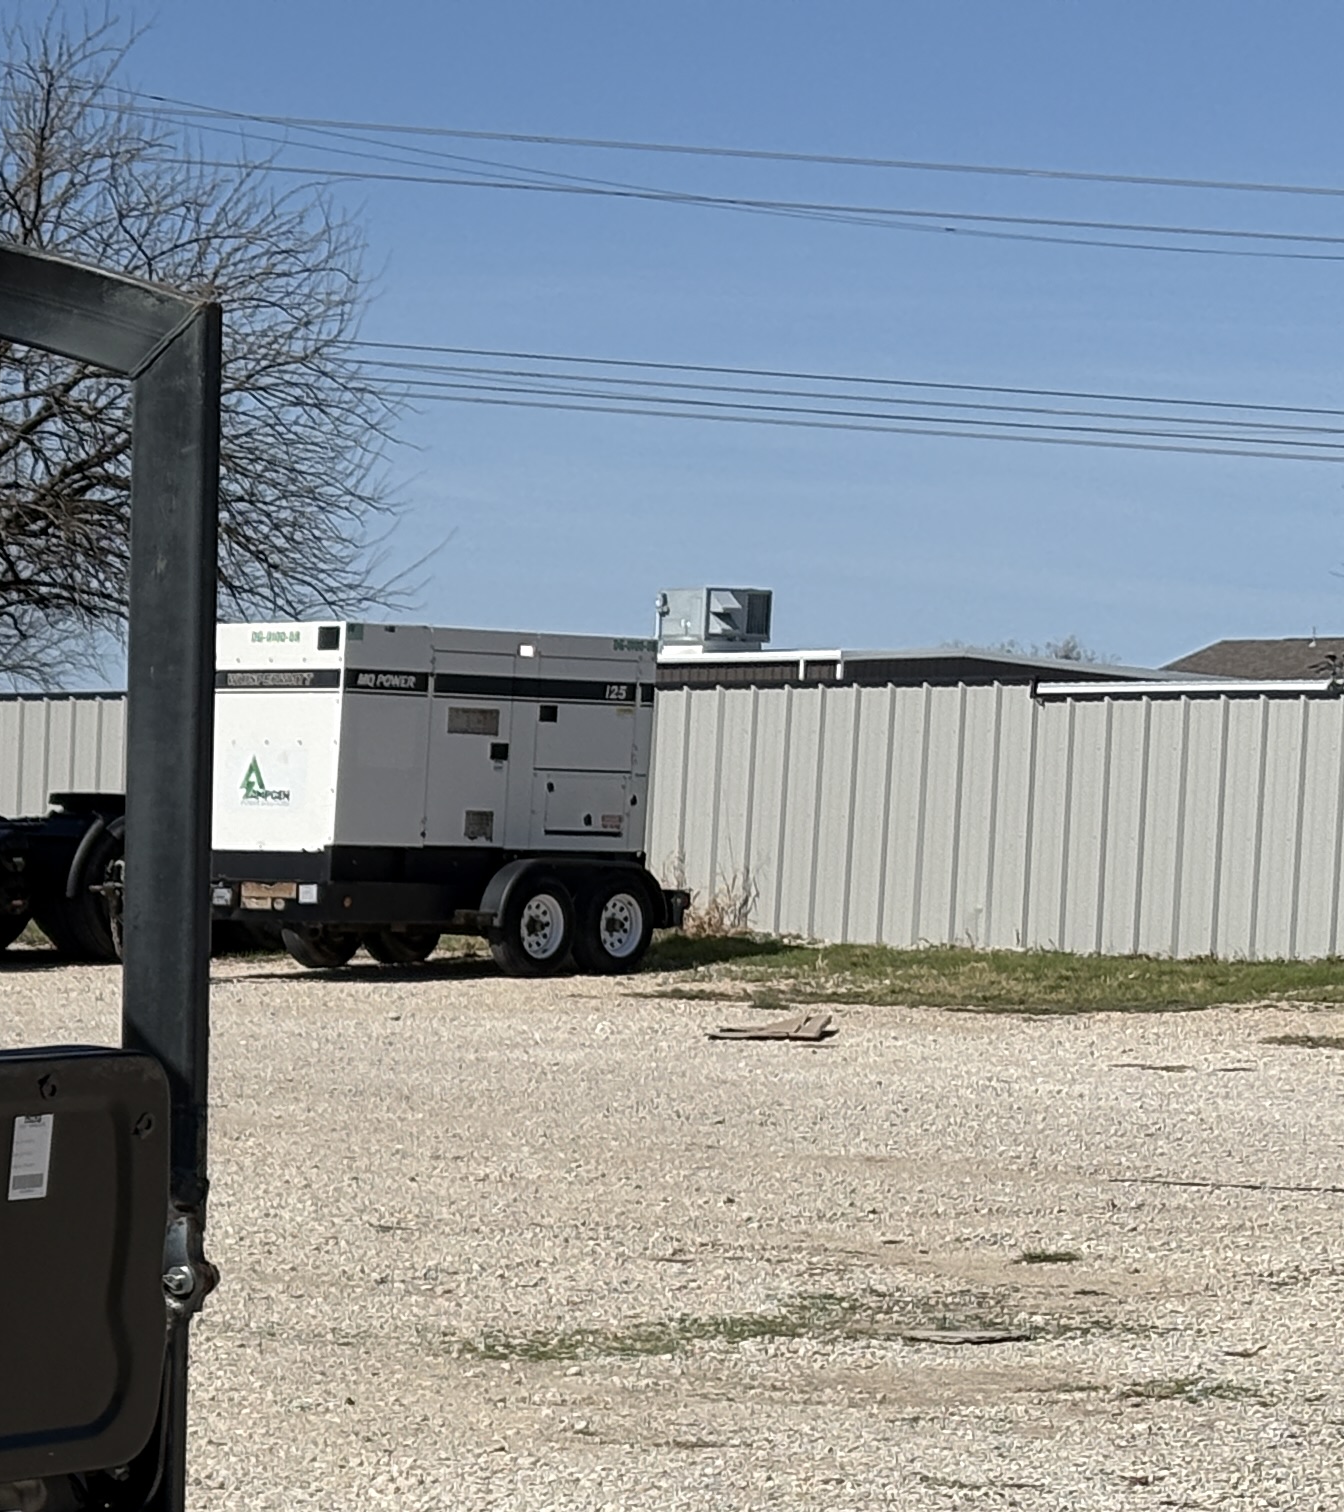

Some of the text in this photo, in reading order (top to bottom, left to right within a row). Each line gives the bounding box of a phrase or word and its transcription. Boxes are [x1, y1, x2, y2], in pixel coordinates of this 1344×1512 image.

[357, 673, 417, 688] MQ POWER
[604, 684, 628, 699] 125
